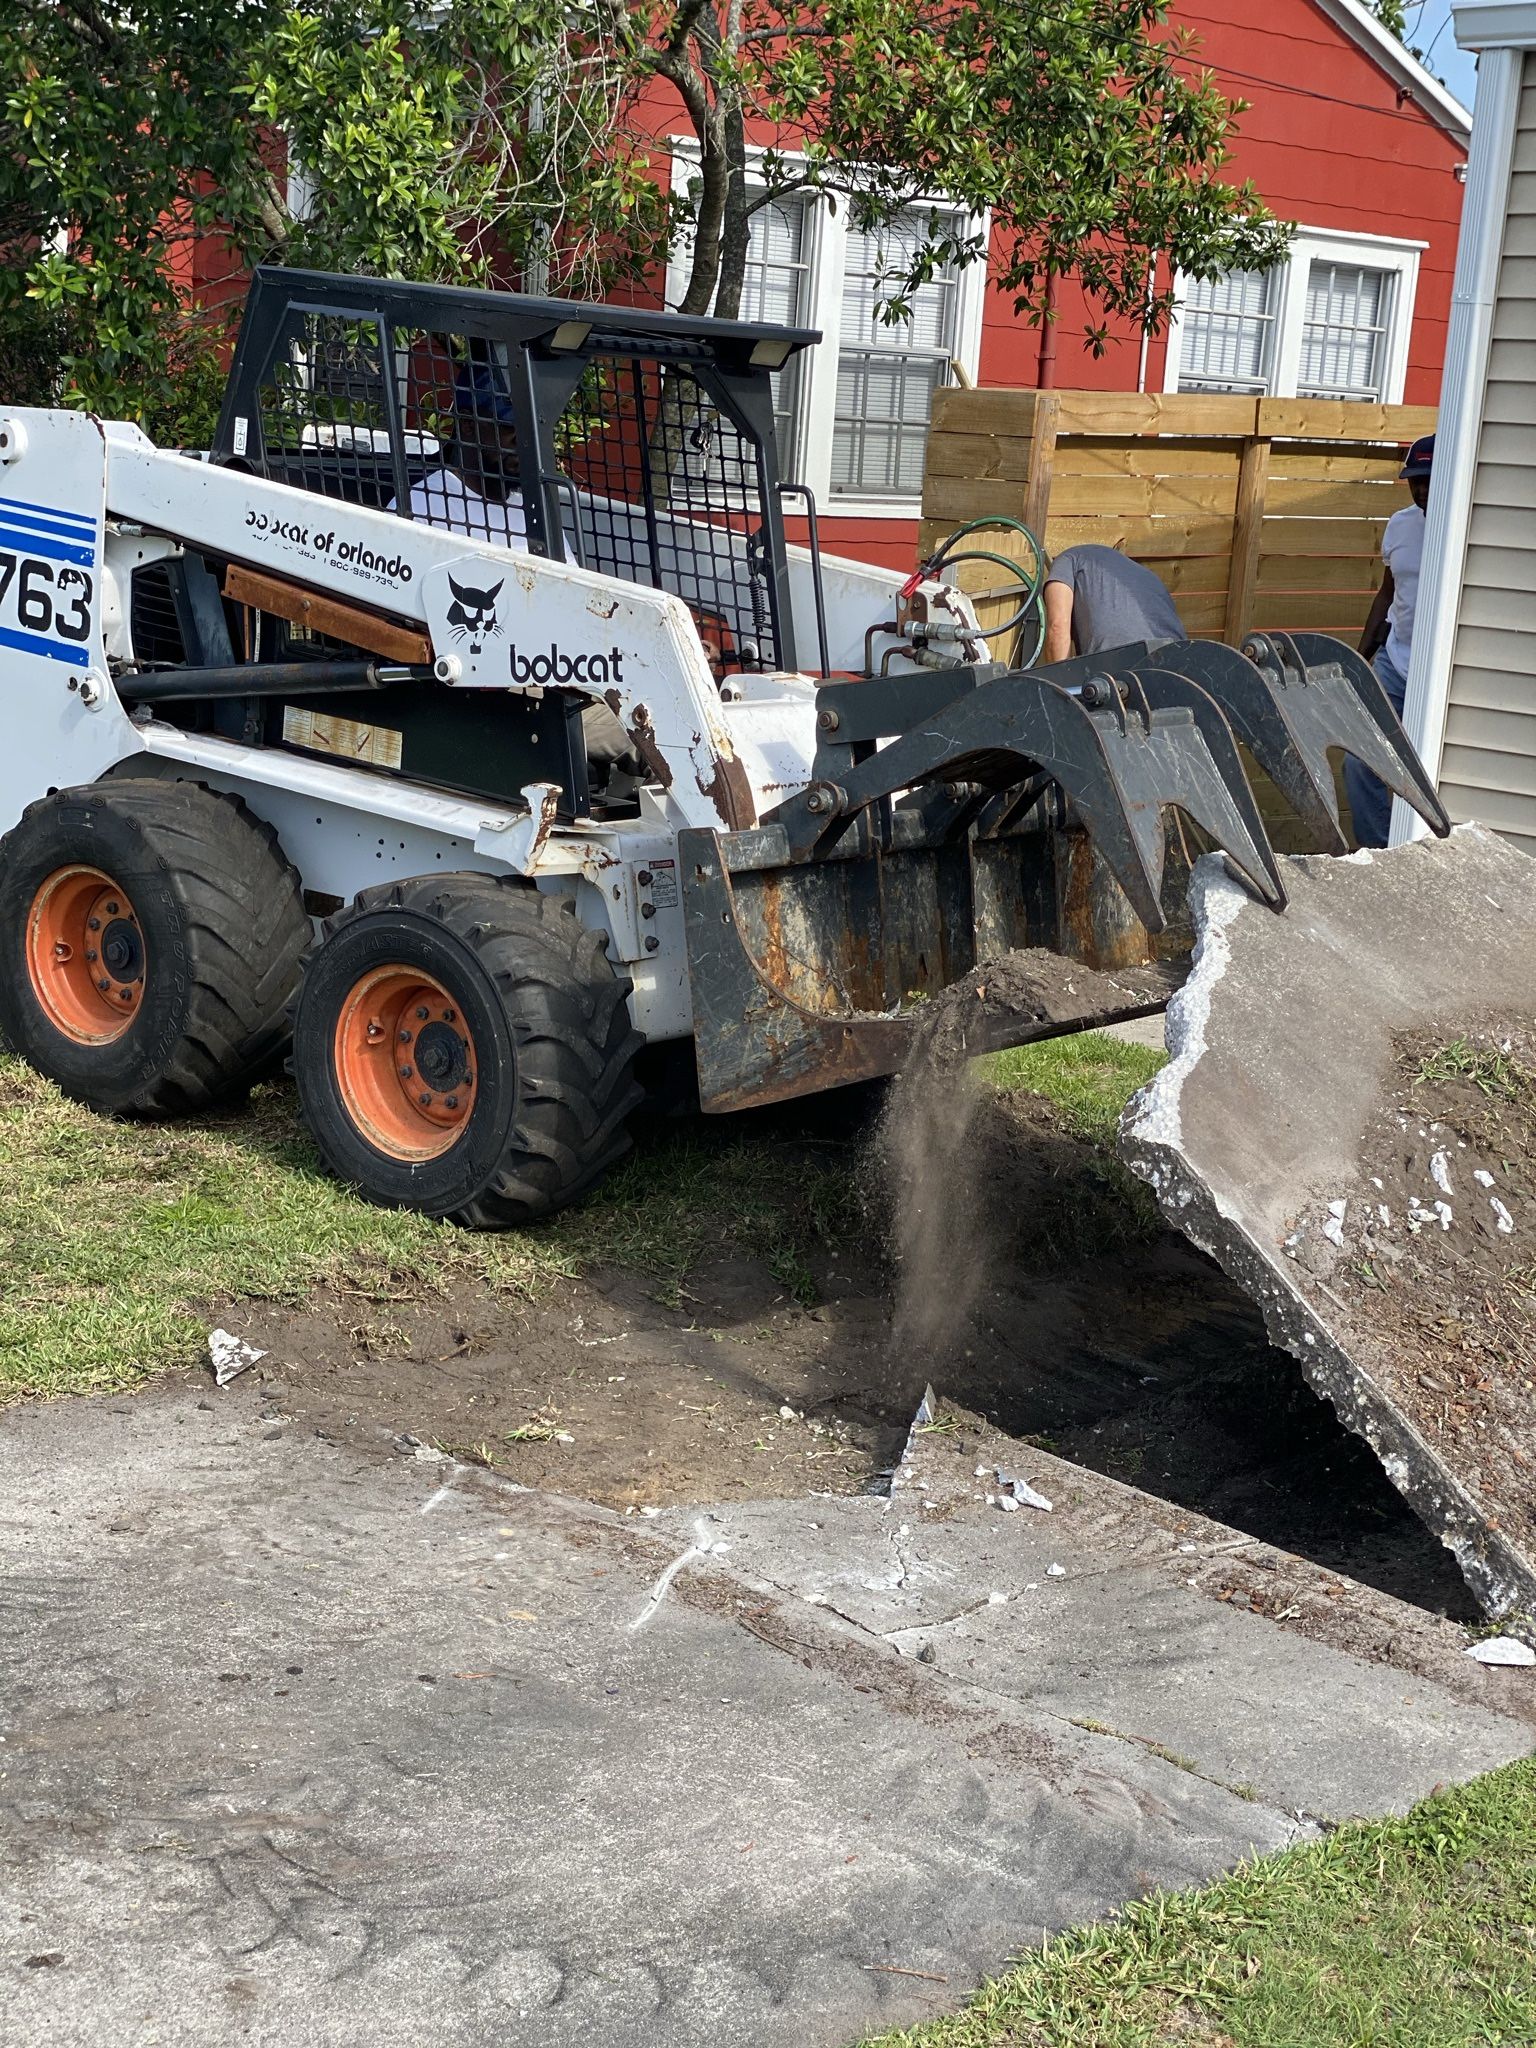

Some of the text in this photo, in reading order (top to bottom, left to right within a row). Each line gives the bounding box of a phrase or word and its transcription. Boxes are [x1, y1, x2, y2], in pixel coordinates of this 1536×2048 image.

[314, 531, 335, 553] of
[337, 541, 413, 582] orlando
[509, 643, 623, 684] bobcat
